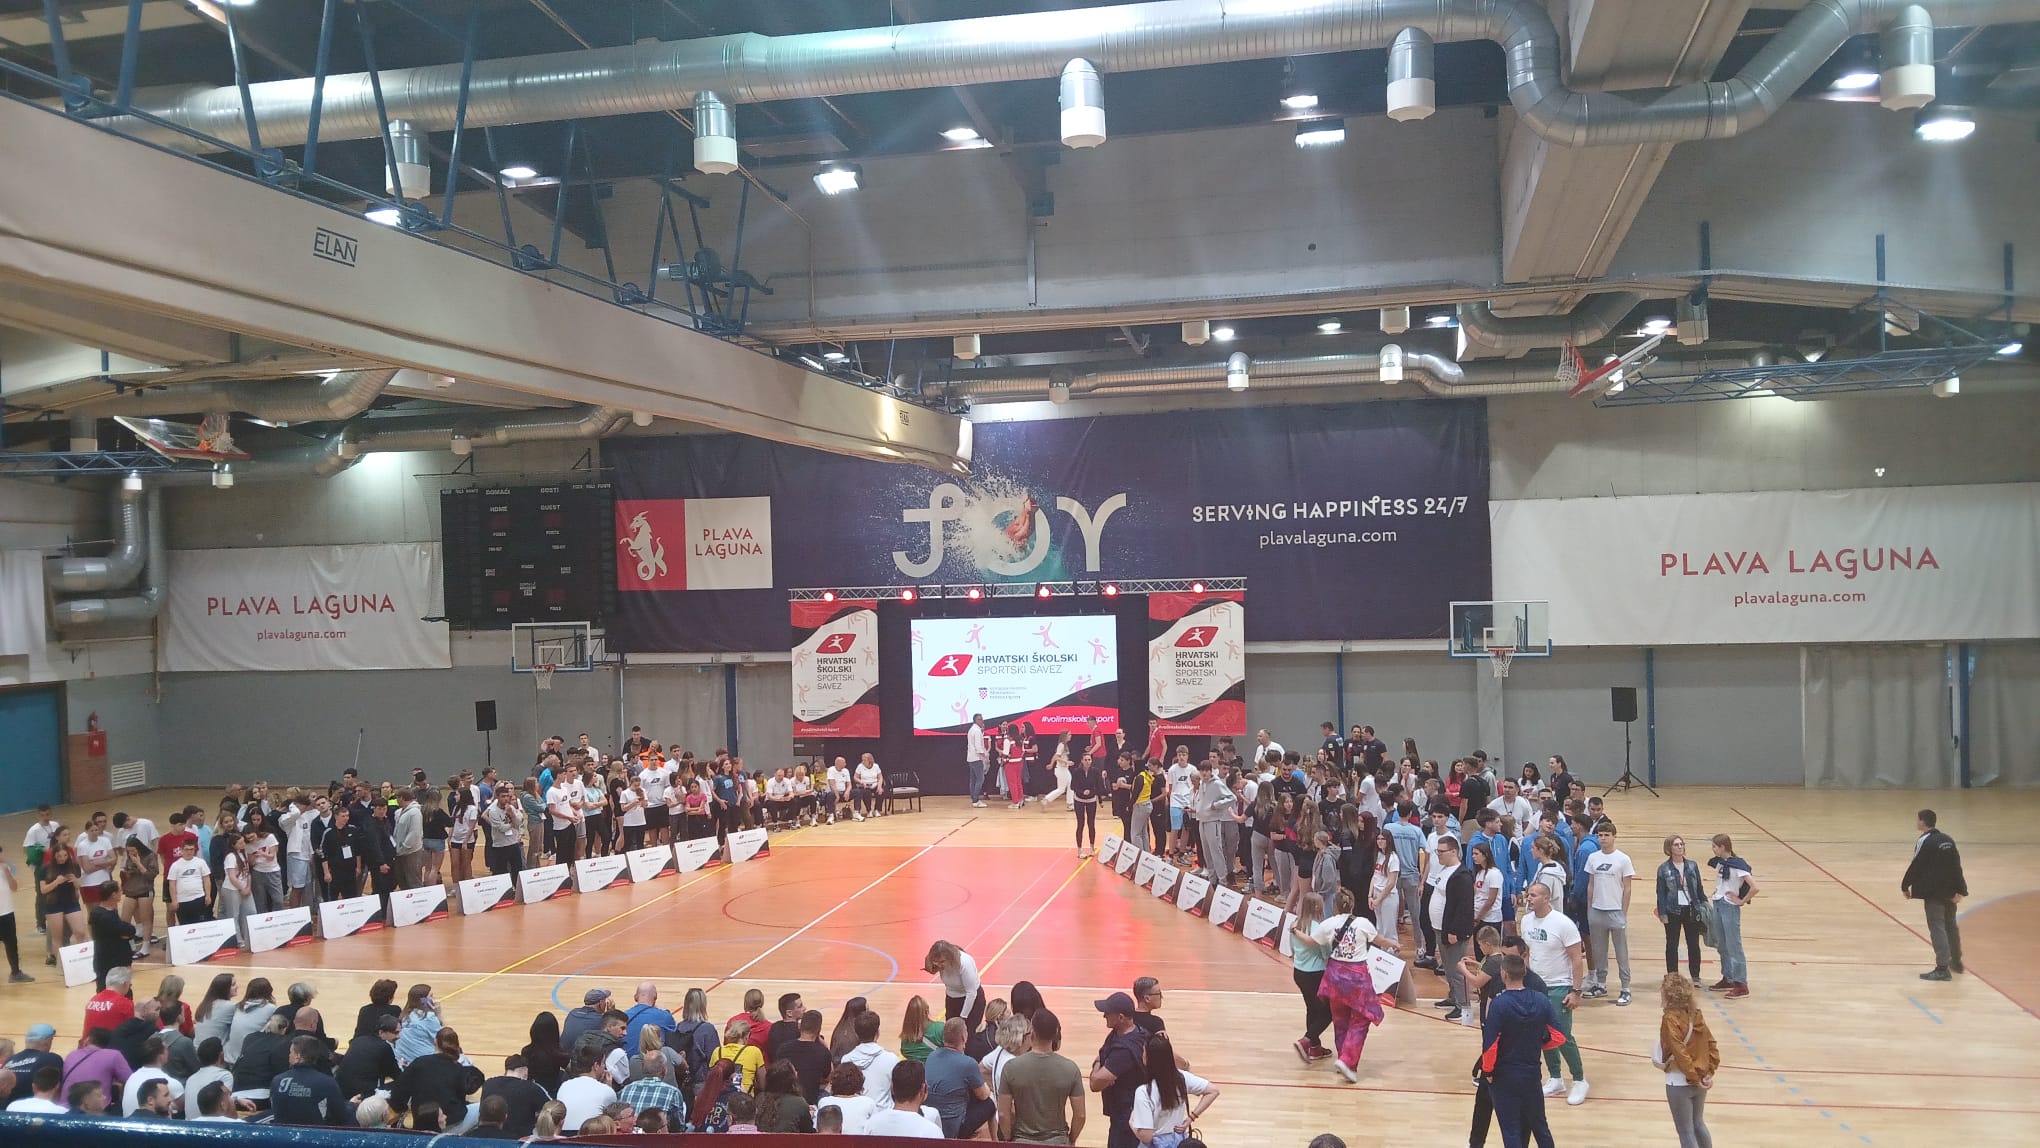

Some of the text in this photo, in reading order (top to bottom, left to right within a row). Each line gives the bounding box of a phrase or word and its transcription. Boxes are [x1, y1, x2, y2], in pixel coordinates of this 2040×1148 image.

[314, 232, 357, 263] ELAN
[1192, 495, 1468, 522] SERVING HAPPINESS 24/7
[703, 527, 753, 541] PLAVA
[1259, 531, 1397, 549] plavalaguna.com
[695, 543, 763, 559] LAGUNA
[1661, 547, 1940, 579] PLAVA LAGUNA
[1734, 591, 1866, 608] plavalaguna.com
[207, 593, 395, 620] PLAVA LAGUNA
[257, 628, 347, 642] plavalaguna.com
[816, 657, 856, 665] HRVATSKI
[977, 652, 1078, 664] HRVATSKI ŠKOLSKI
[1175, 651, 1219, 659] HRVATSKI
[816, 664, 852, 673] ŠKOLSKI
[977, 664, 1063, 675] SPORTSKI SAVEZ
[1175, 659, 1214, 668] ŠKOLSKI
[816, 674, 855, 682] SPORTSKI
[1175, 669, 1217, 677] SPORTSKI
[1175, 678, 1203, 686] SAVEZ
